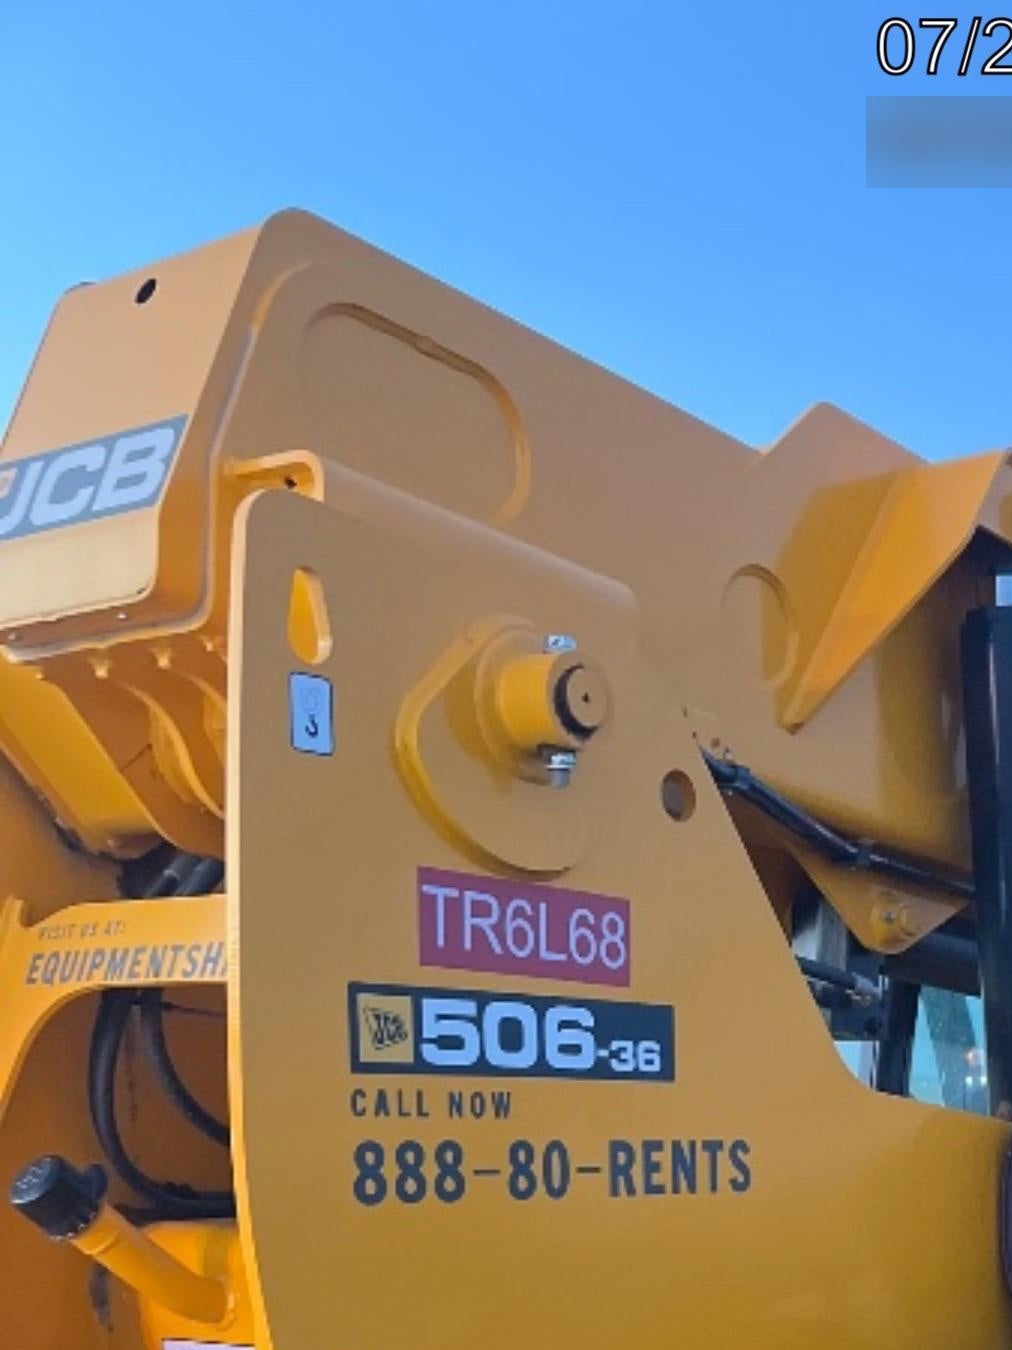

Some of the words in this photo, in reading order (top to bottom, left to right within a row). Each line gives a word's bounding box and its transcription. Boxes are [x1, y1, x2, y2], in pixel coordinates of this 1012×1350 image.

[0, 427, 176, 536] JCB
[421, 882, 627, 970] TR6L68
[25, 941, 228, 985] EQUIPMENTSH
[420, 998, 661, 1073] 506-36
[350, 1088, 429, 1118] CALL
[448, 1090, 511, 1119] NOW
[353, 1138, 751, 1205] 888-80-RENTS
